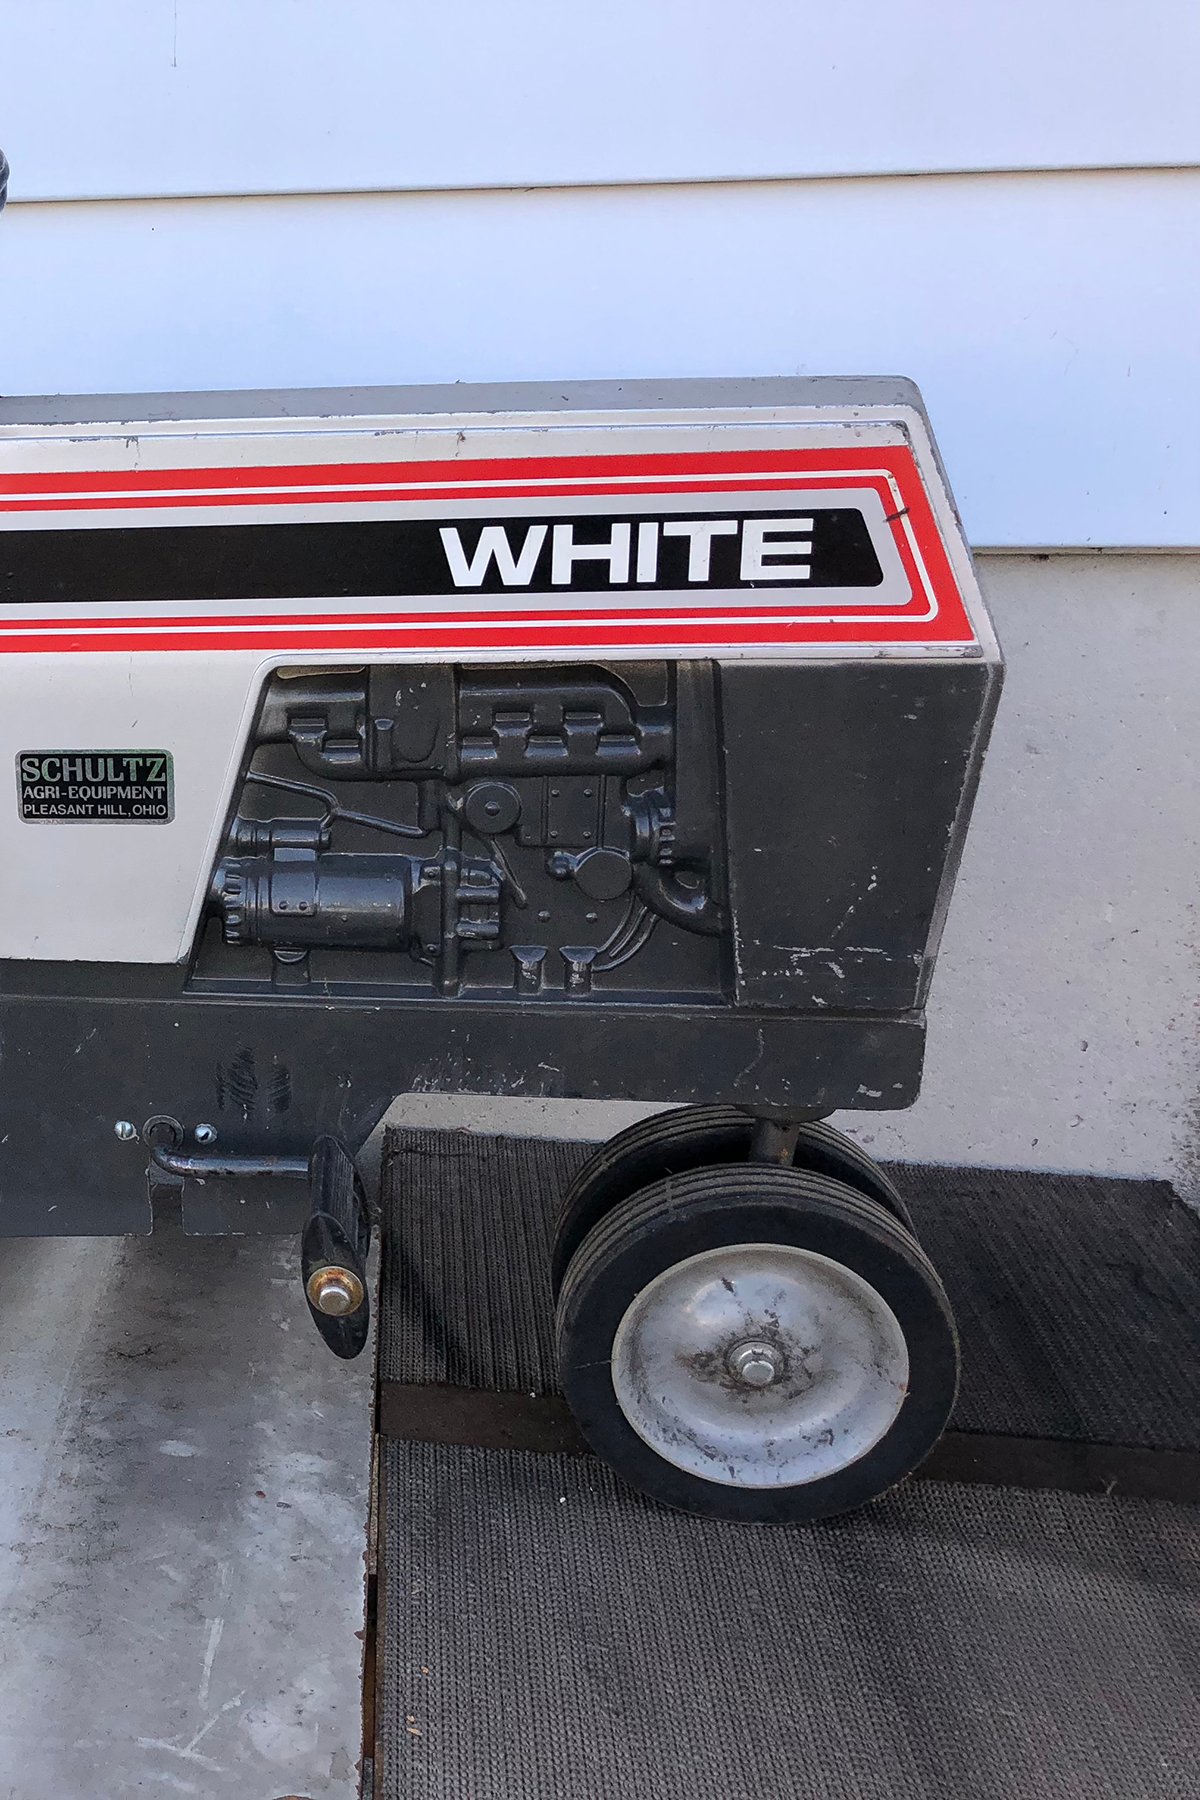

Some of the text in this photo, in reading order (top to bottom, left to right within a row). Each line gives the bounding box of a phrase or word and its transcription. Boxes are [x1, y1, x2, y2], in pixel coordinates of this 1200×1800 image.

[438, 517, 815, 588] WHITE
[21, 757, 166, 782] SCHULTZ
[23, 785, 166, 801] AGRI-EQUIPMENT
[23, 804, 94, 815] PLEASANT
[132, 804, 167, 816] OHIO
